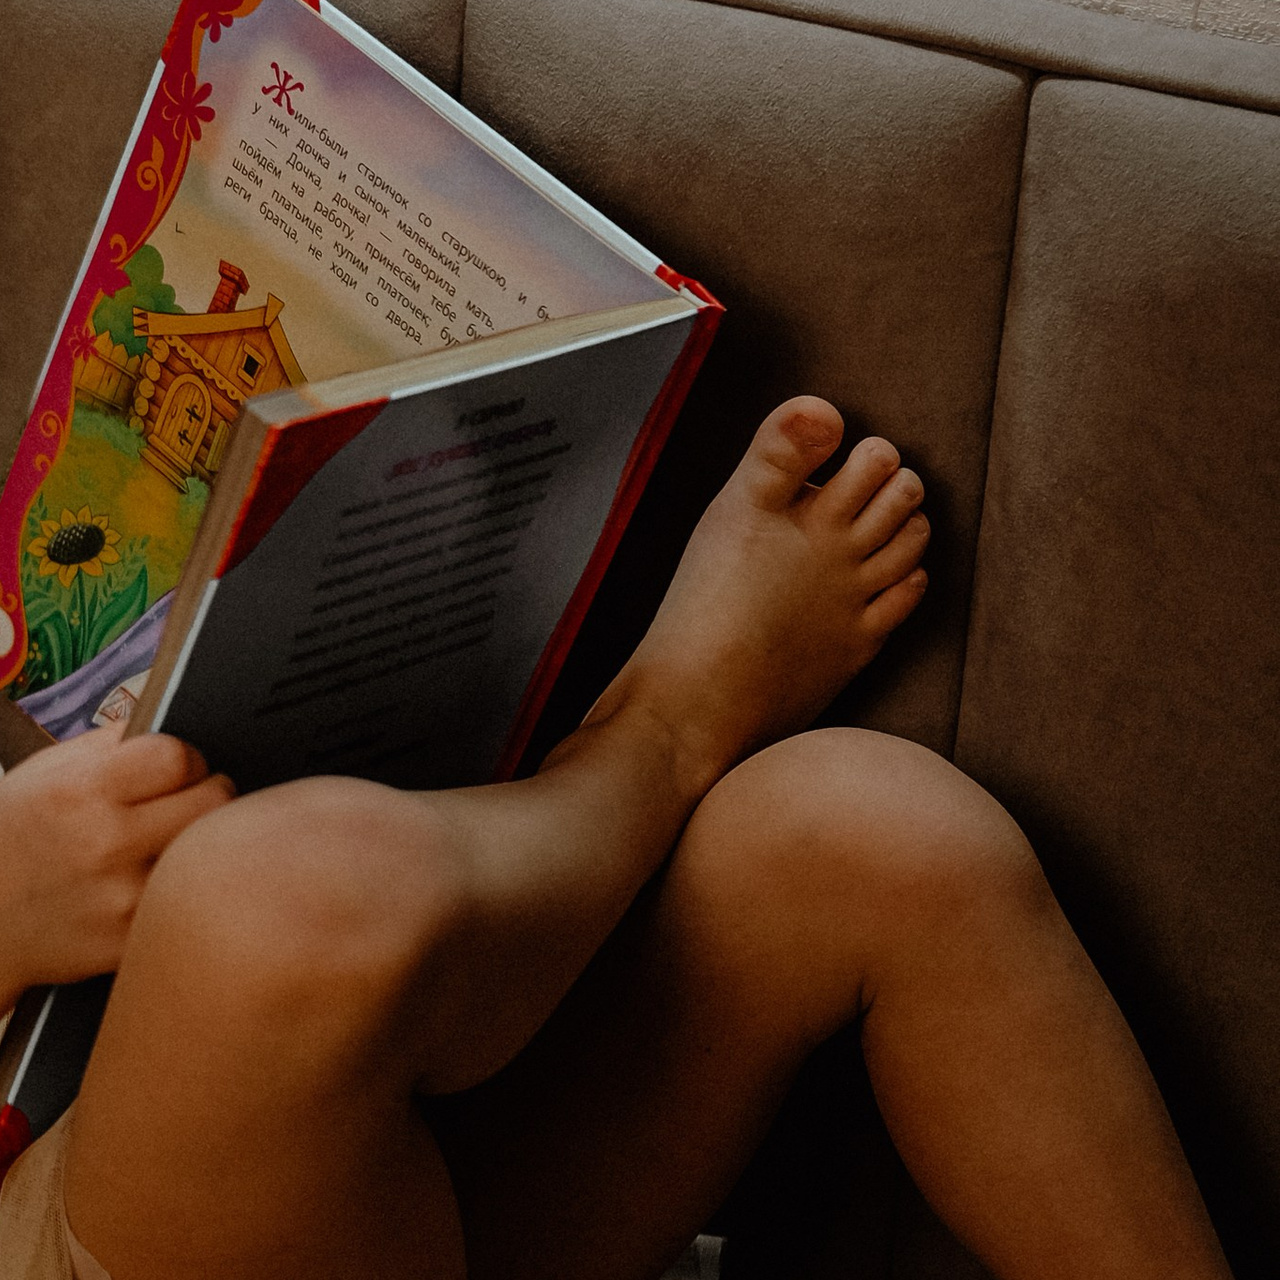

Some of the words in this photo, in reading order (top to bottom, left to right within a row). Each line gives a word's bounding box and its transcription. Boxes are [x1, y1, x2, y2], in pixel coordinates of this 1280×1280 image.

[224, 176, 251, 202] реги
[260, 201, 298, 243] братца,
[308, 244, 322, 260] не
[330, 262, 357, 289] ходи
[366, 292, 379, 307] со
[385, 309, 424, 346] двора.
[232, 158, 263, 188] шьём
[272, 190, 322, 239] платьице,
[333, 241, 368, 275] купим
[377, 277, 432, 329] платочек;
[239, 140, 281, 179] пойдём
[291, 182, 305, 198] на
[313, 201, 355, 242] работу,
[365, 242, 420, 293] принесём
[431, 295, 456, 322] тебе
[252, 102, 262, 115] у
[269, 115, 290, 137] них
[296, 139, 330, 169] дочка
[338, 171, 346, 183] и
[355, 185, 389, 218] сынок
[397, 220, 461, 278] маленький.
[286, 152, 322, 192] Дочка,
[332, 192, 370, 227] дочка!
[402, 249, 456, 297] говорила
[465, 300, 495, 331] мать.
[358, 163, 409, 210] старичок
[418, 212, 433, 228] со
[442, 231, 507, 291] старушкою,
[518, 293, 527, 304] и
